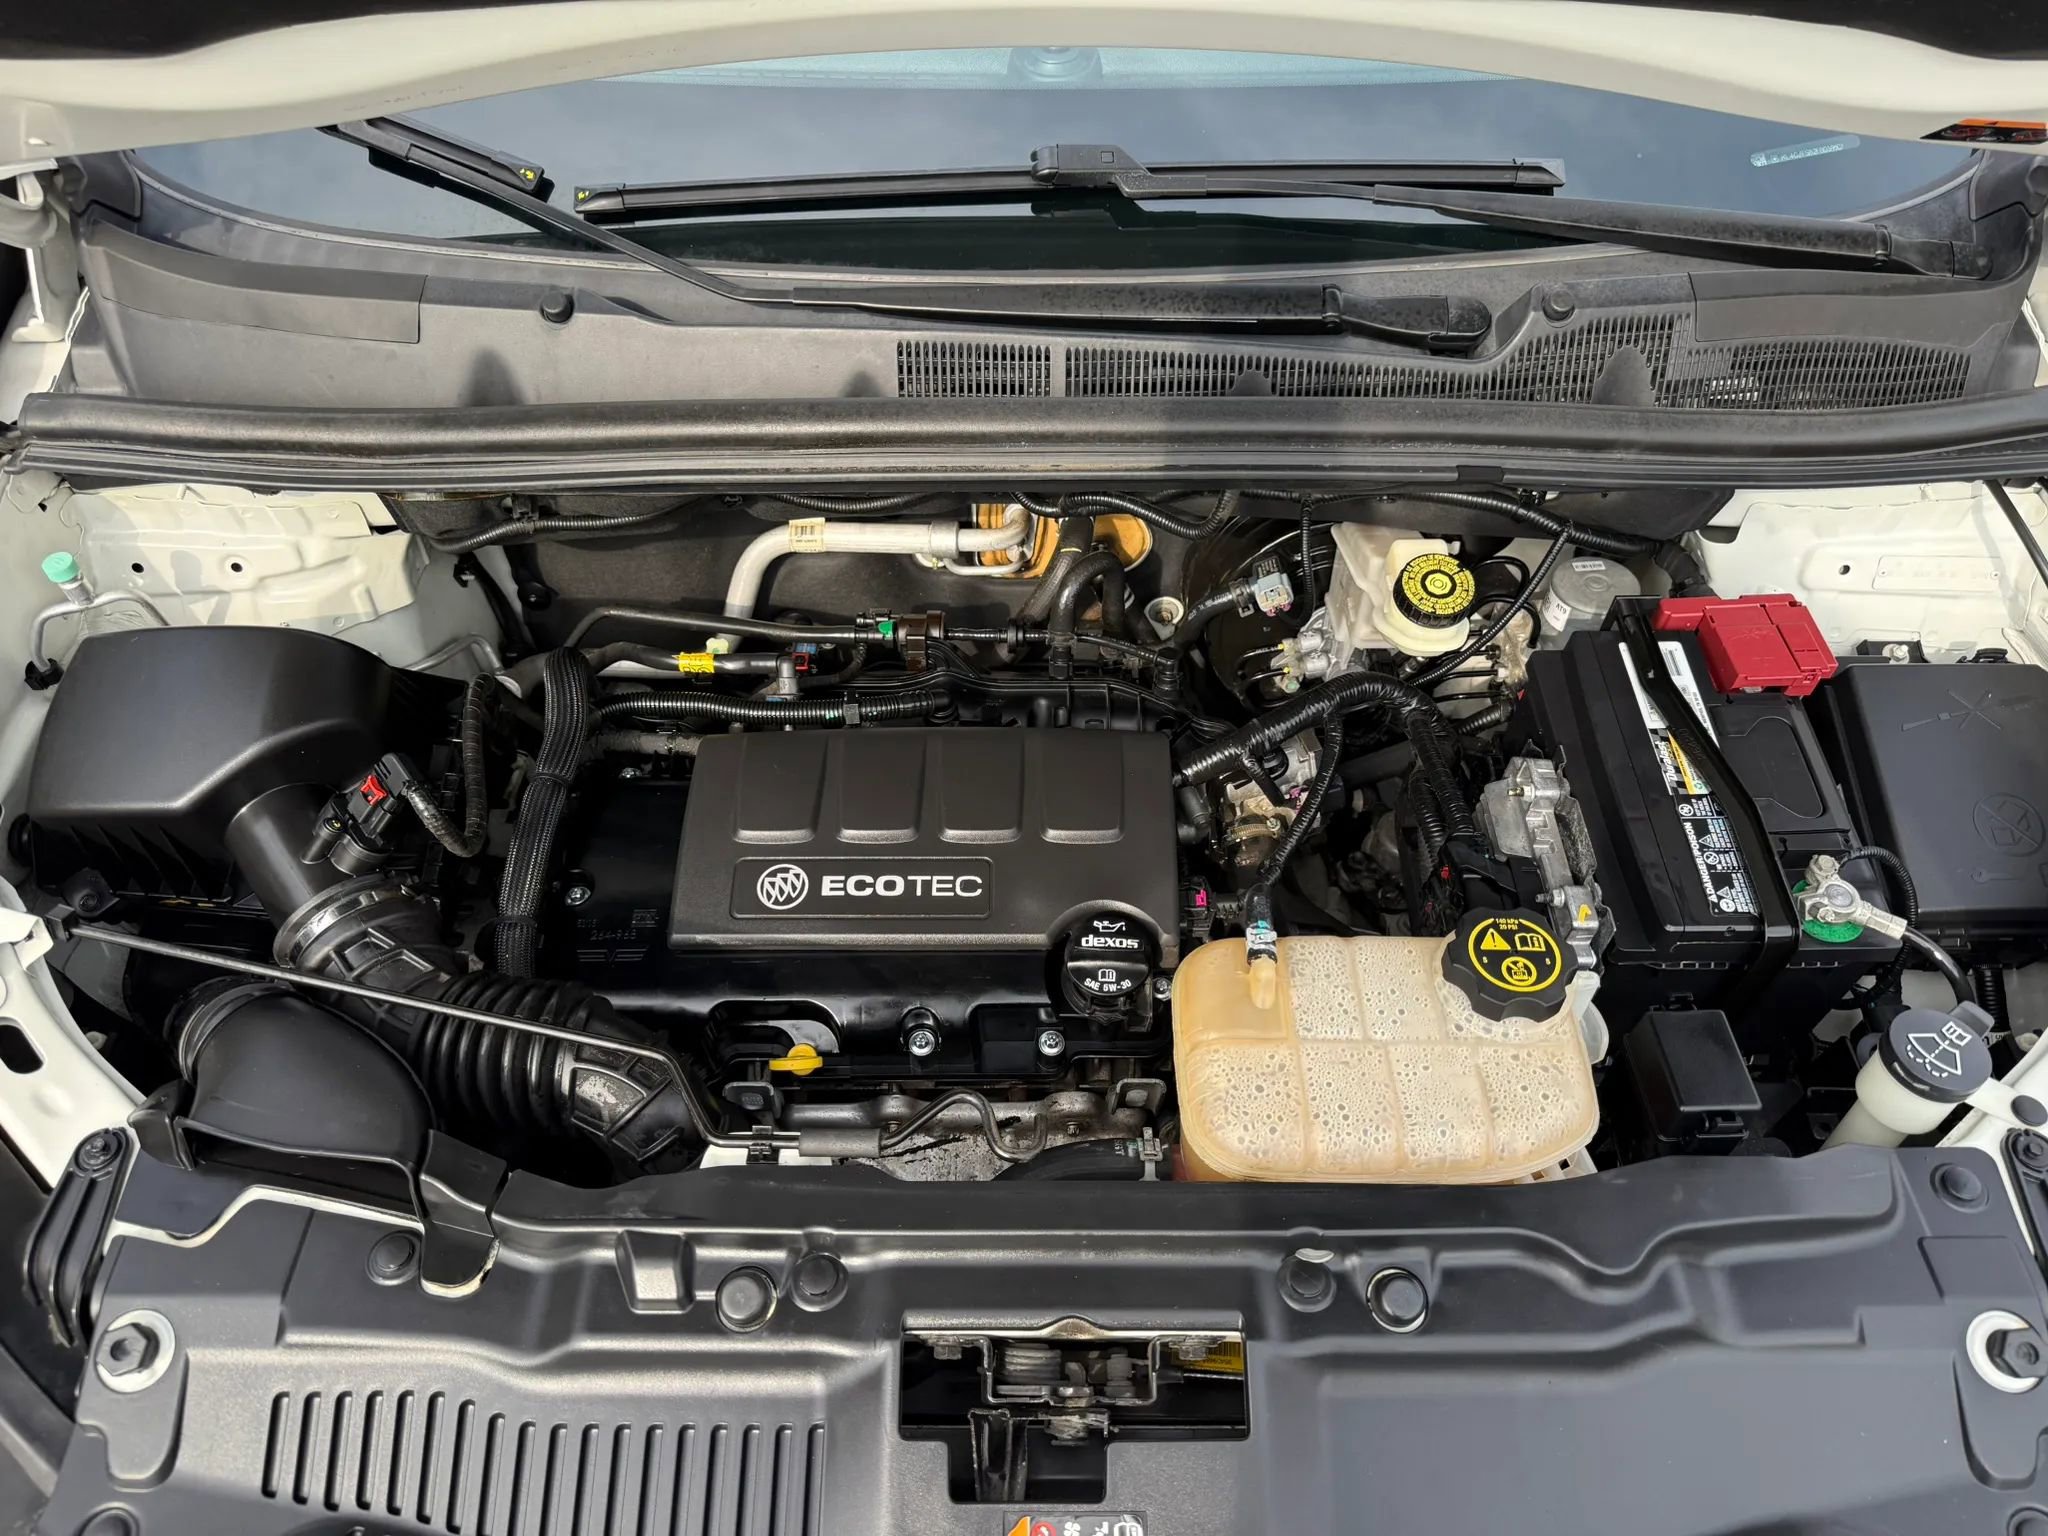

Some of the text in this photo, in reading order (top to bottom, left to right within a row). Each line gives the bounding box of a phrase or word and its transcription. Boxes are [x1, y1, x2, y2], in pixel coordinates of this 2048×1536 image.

[1655, 741, 1678, 782] Duralast
[1683, 822, 1715, 895] DANGER/POISON
[821, 875, 983, 897] ECOTEC
[1081, 934, 1140, 949] dexos
[1084, 978, 1132, 992] SAE 5W-30
